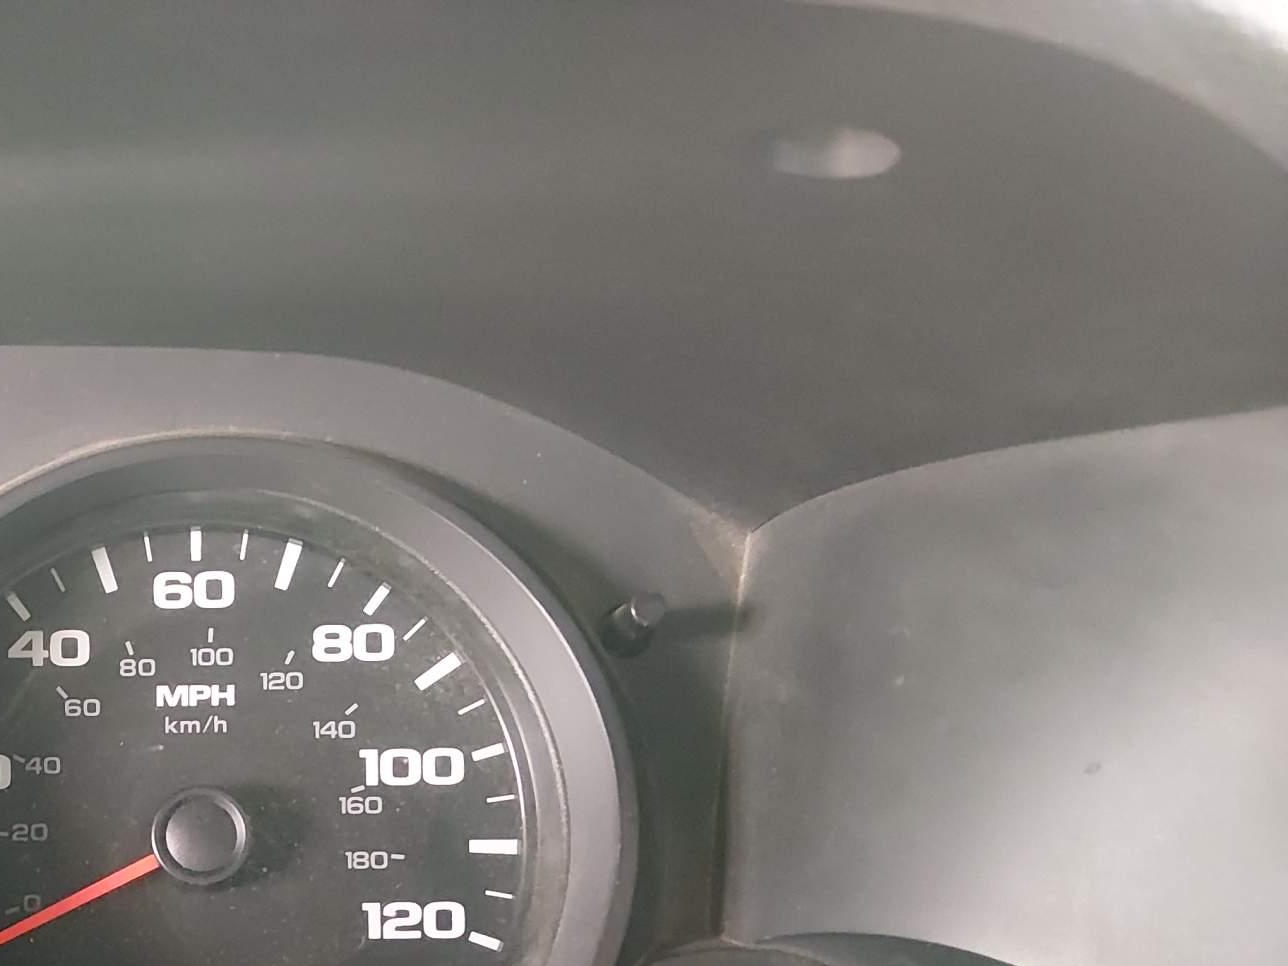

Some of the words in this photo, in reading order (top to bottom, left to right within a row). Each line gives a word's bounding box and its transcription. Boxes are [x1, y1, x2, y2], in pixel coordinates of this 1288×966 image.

[153, 571, 235, 609] 60
[8, 630, 90, 666] 40
[312, 624, 395, 662] 80
[190, 648, 234, 666] 100
[120, 659, 156, 677] 80
[260, 672, 304, 690] 120
[156, 685, 235, 707] MPH
[64, 699, 100, 717] 60
[164, 715, 227, 734] km/h
[313, 721, 356, 739] 140
[24, 757, 61, 775] 40
[359, 748, 464, 786] 100
[339, 796, 383, 815] 160
[12, 824, 48, 841] 20
[345, 852, 388, 869] 180
[361, 902, 466, 940] 120
